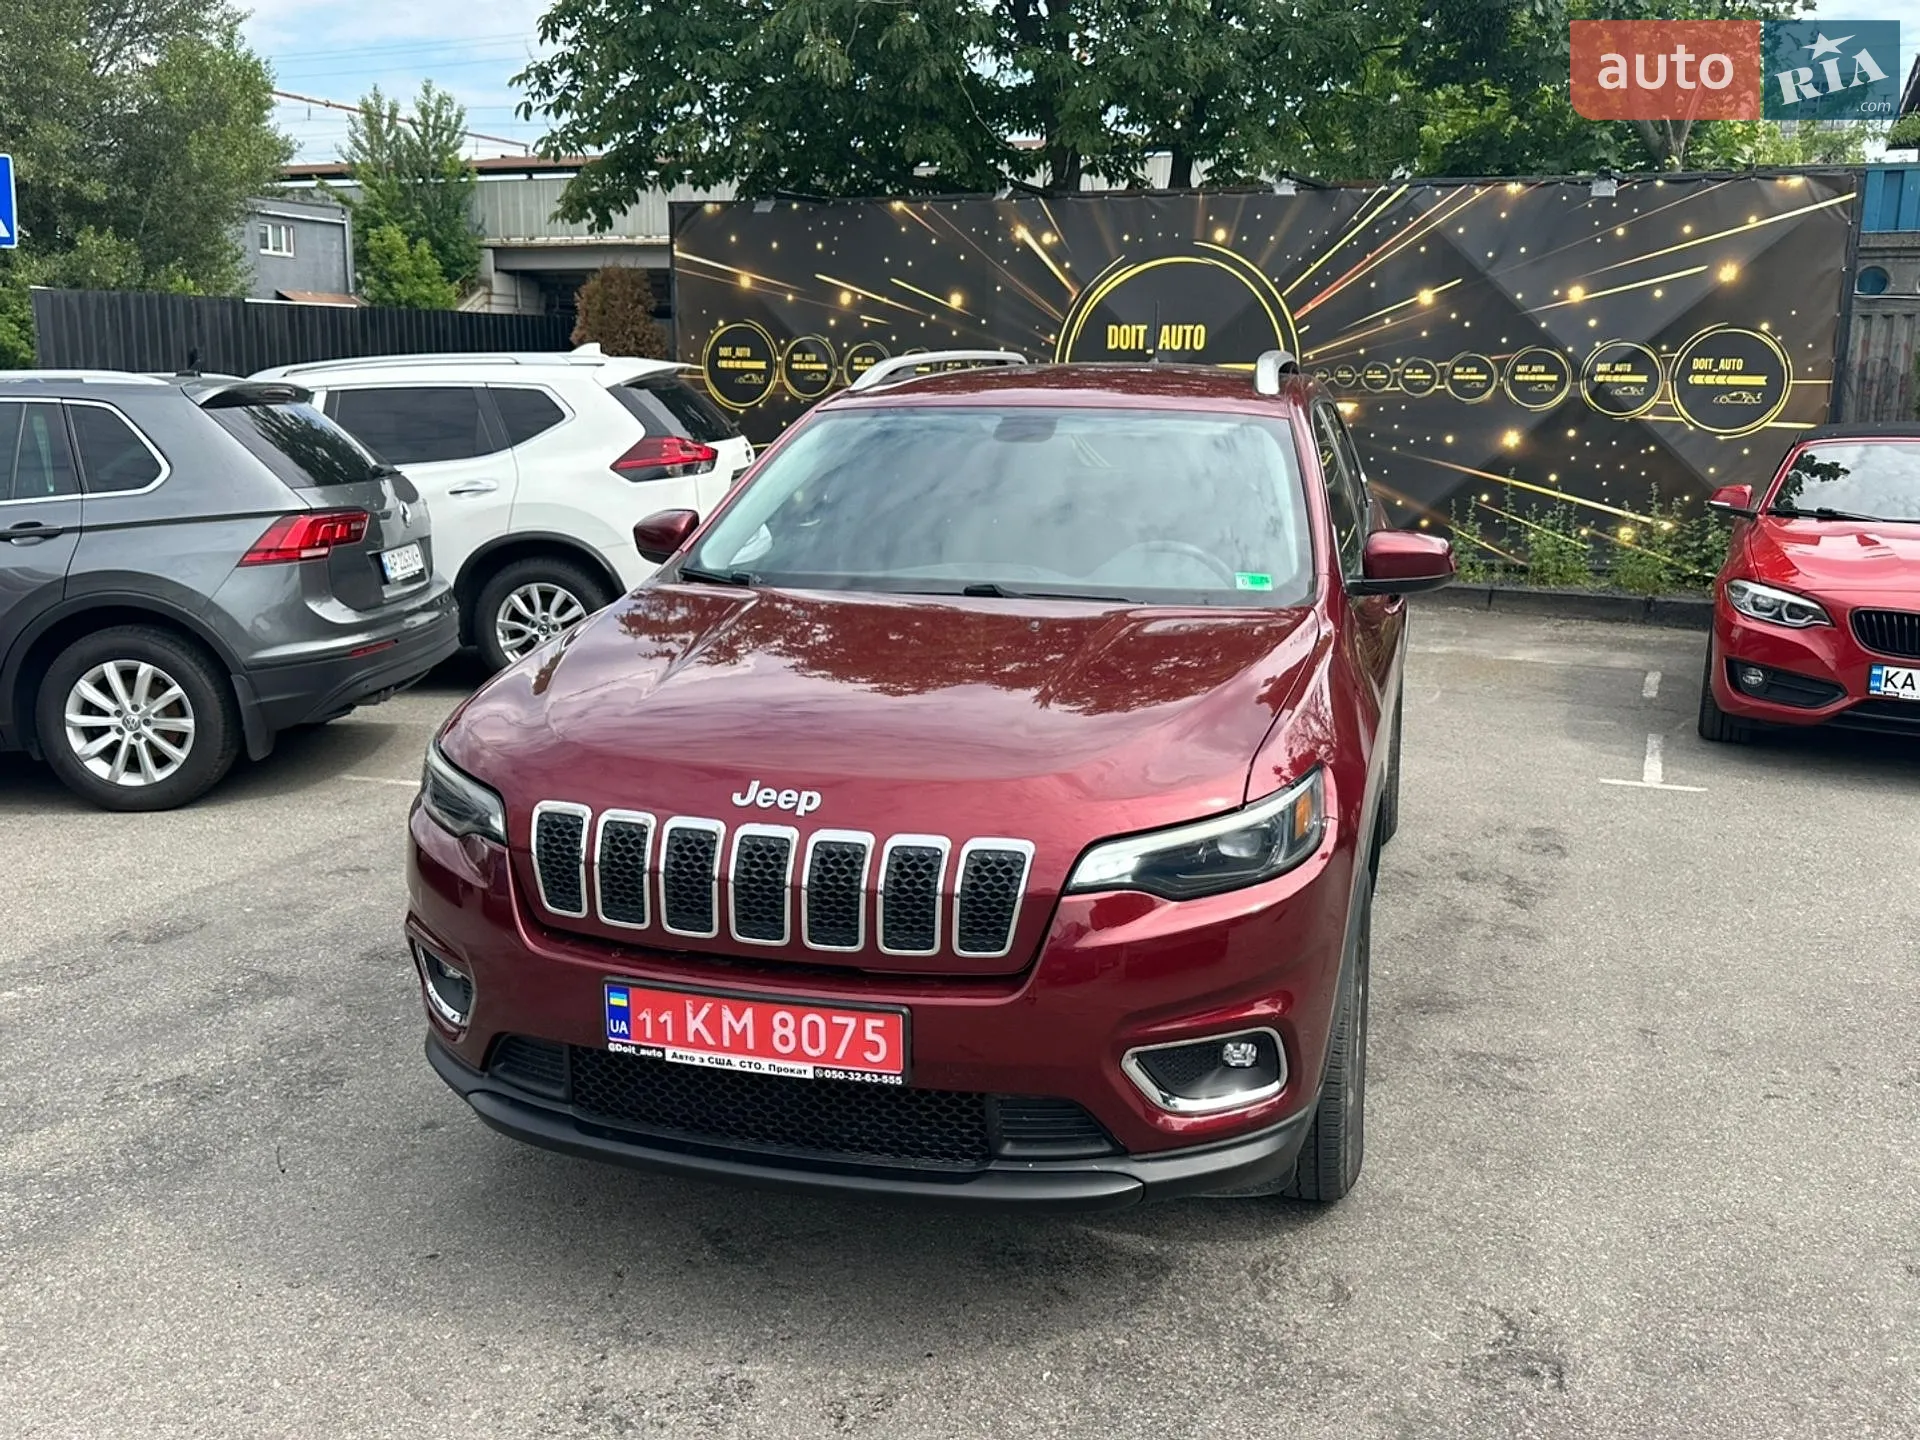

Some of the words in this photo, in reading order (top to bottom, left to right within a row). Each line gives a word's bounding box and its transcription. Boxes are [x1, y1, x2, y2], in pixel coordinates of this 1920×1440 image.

[1106, 324, 1207, 354] DOIT_AUTO
[1691, 357, 1744, 373] DOIT_AUTO
[1884, 670, 1916, 691] KA
[731, 779, 822, 817] Jeep
[609, 1020, 629, 1036] UA
[771, 1010, 889, 1064] 8075
[671, 1051, 696, 1063] Авто
[768, 1063, 808, 1076] Прокат
